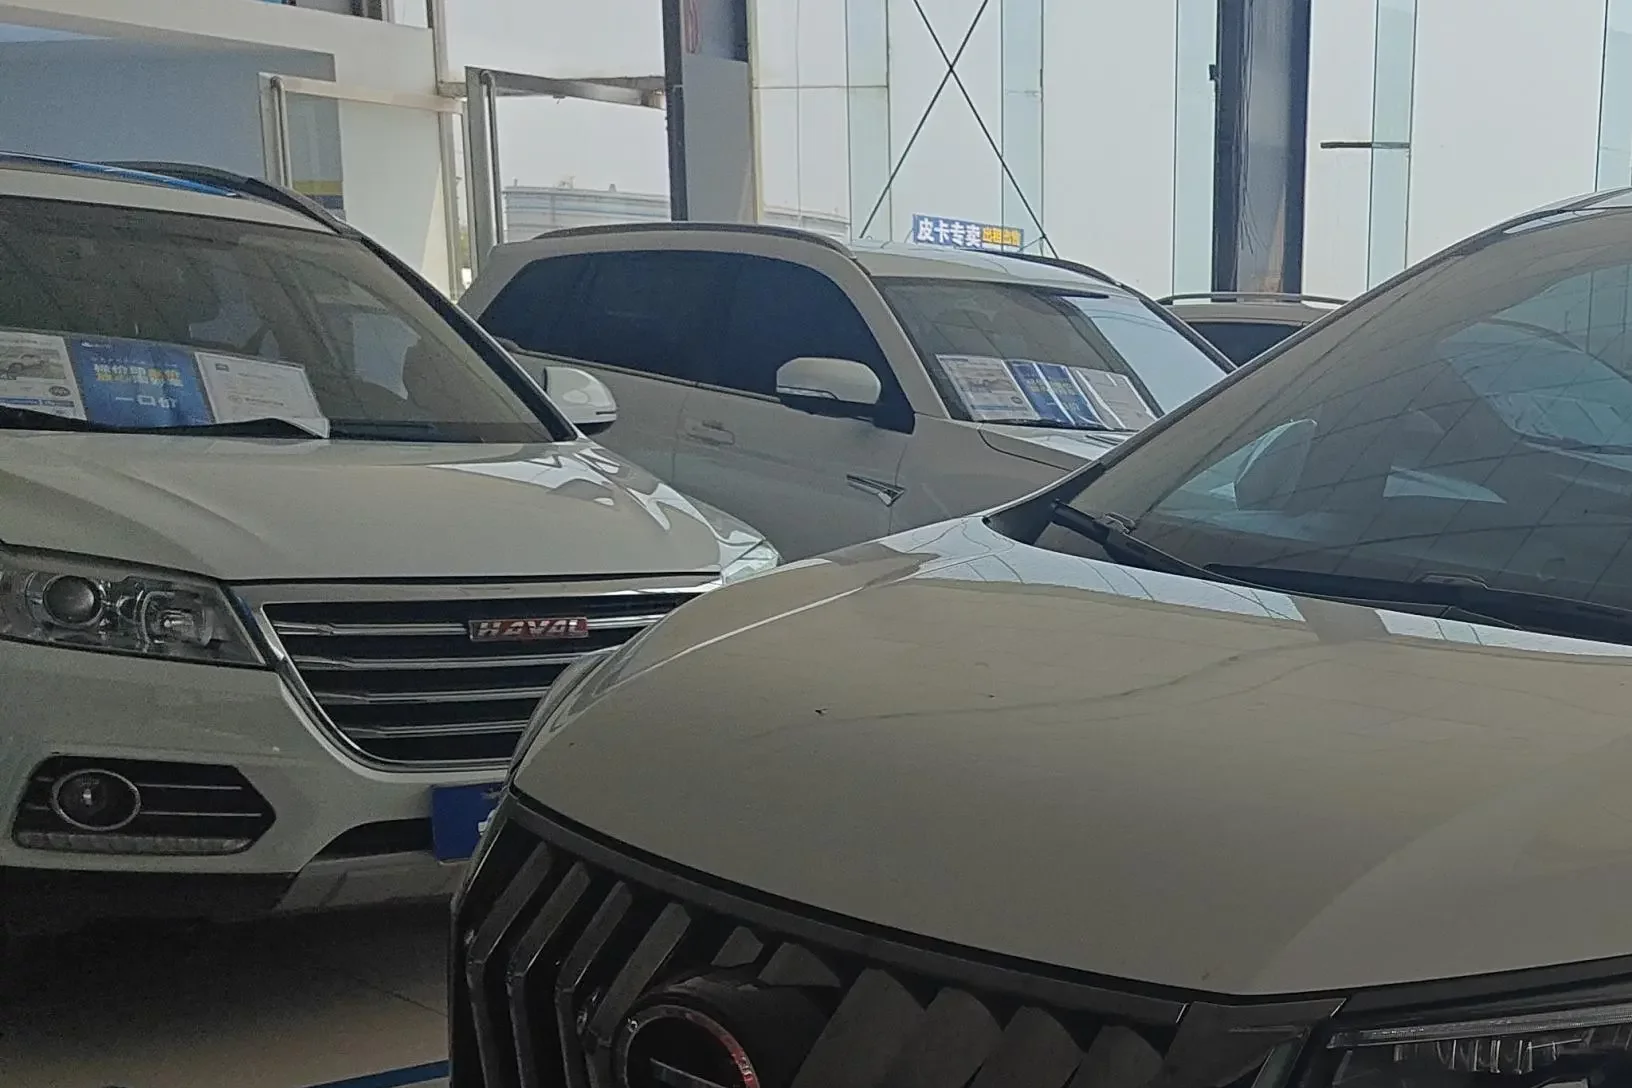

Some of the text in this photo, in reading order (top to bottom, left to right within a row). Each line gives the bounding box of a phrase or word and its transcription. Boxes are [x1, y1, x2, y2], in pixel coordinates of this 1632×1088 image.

[917, 217, 983, 249] 皮卡专卖
[476, 619, 581, 637] HAVAL
